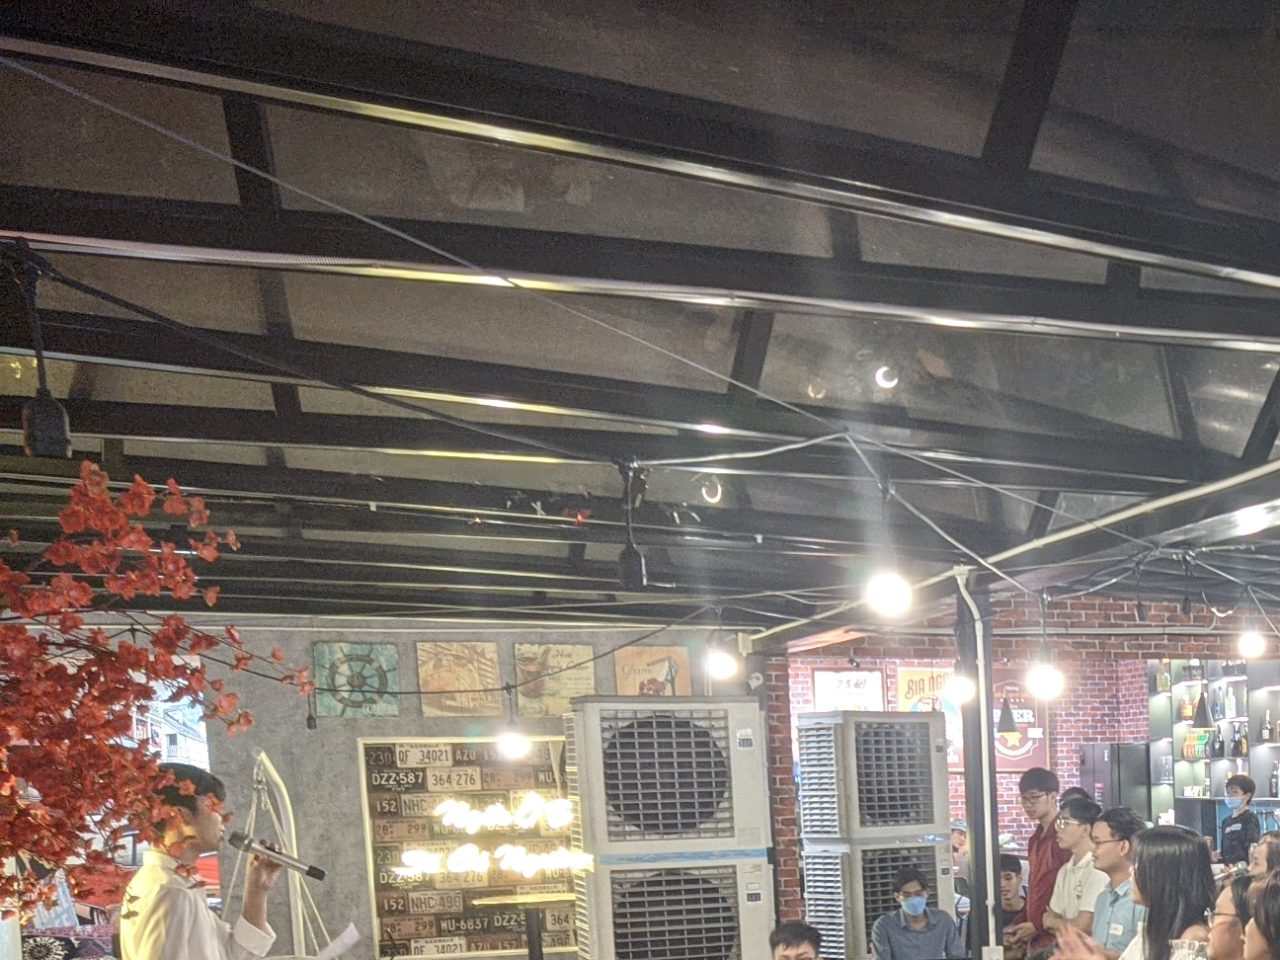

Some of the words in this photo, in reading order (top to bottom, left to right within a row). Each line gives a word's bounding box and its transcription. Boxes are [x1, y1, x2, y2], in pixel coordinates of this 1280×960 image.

[904, 678, 925, 700] BIA
[419, 749, 449, 762] 34021
[376, 800, 397, 812] 152
[383, 898, 404, 910] 152
